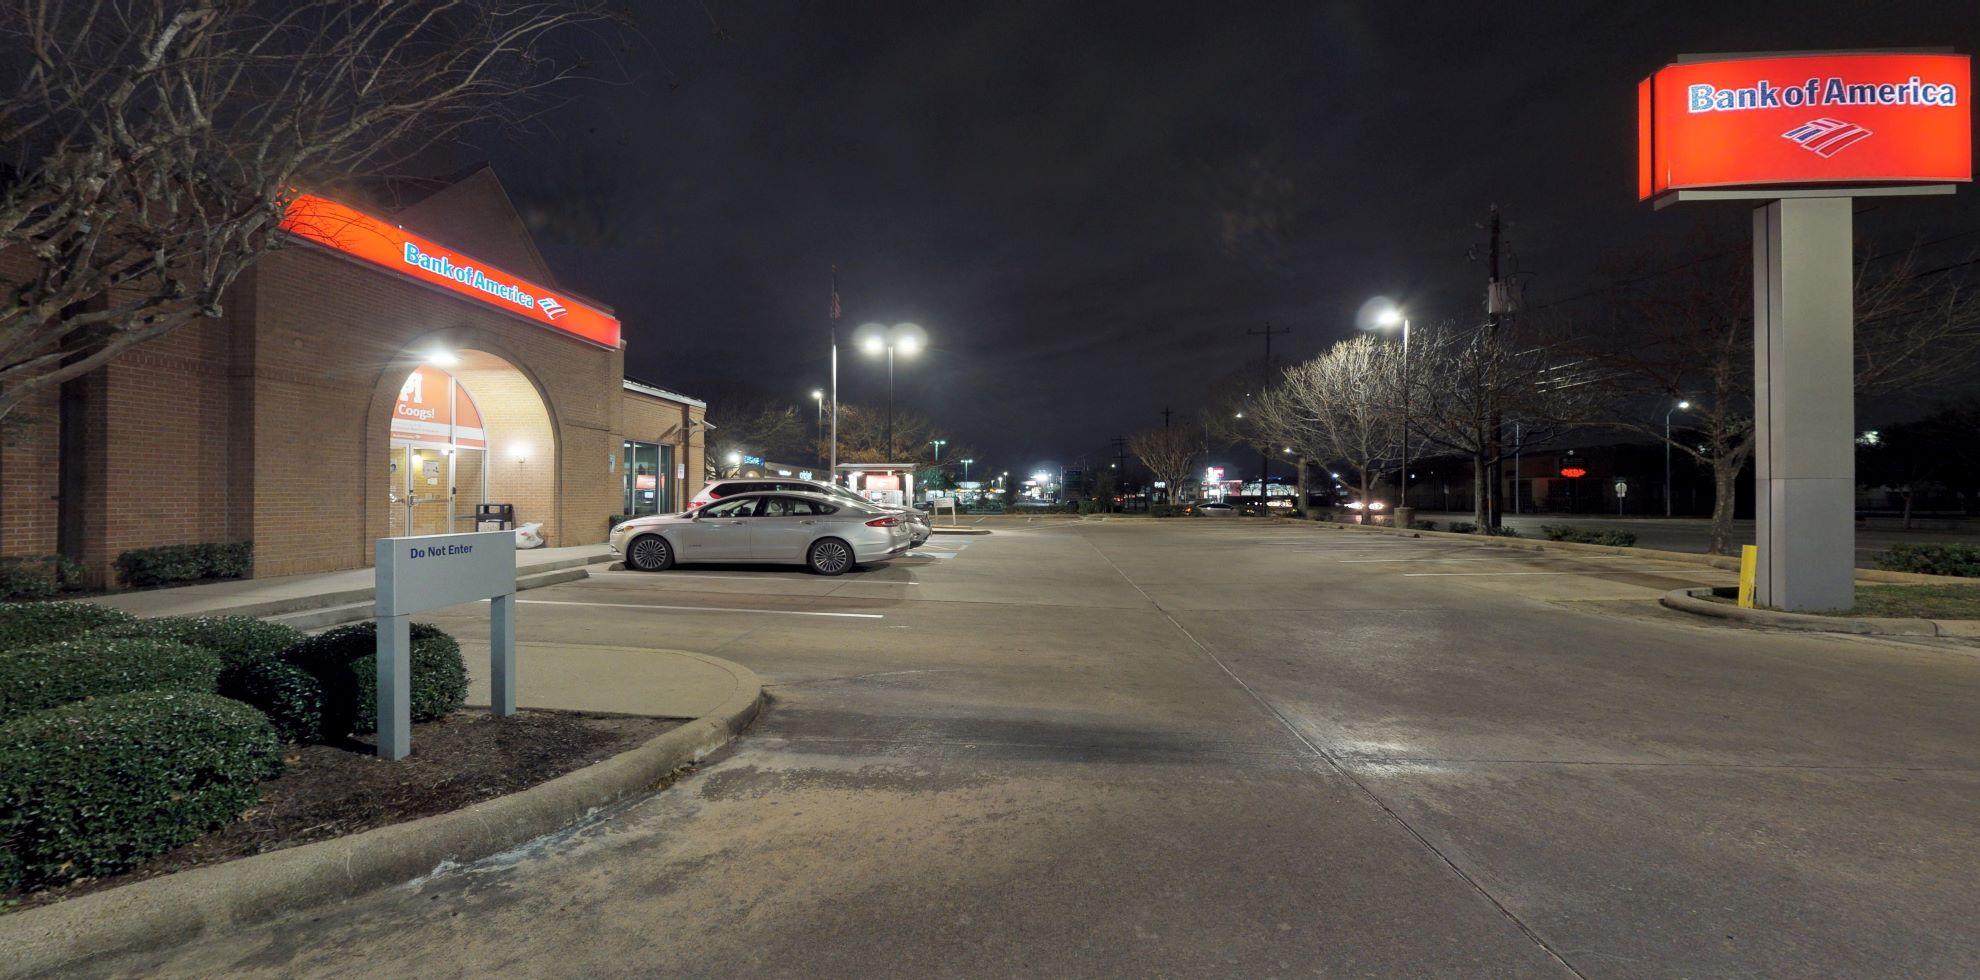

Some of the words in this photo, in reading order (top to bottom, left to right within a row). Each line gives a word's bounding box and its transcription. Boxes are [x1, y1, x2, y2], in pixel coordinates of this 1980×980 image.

[1688, 80, 1781, 113] Bank
[1784, 77, 1819, 106] of
[1822, 76, 1958, 107] America
[404, 241, 455, 279] Bank
[454, 266, 474, 286] of
[473, 271, 535, 309] America
[398, 403, 435, 420] Coogs!
[410, 548, 425, 559] Do
[428, 545, 446, 557] Not
[448, 544, 473, 555] Enter
